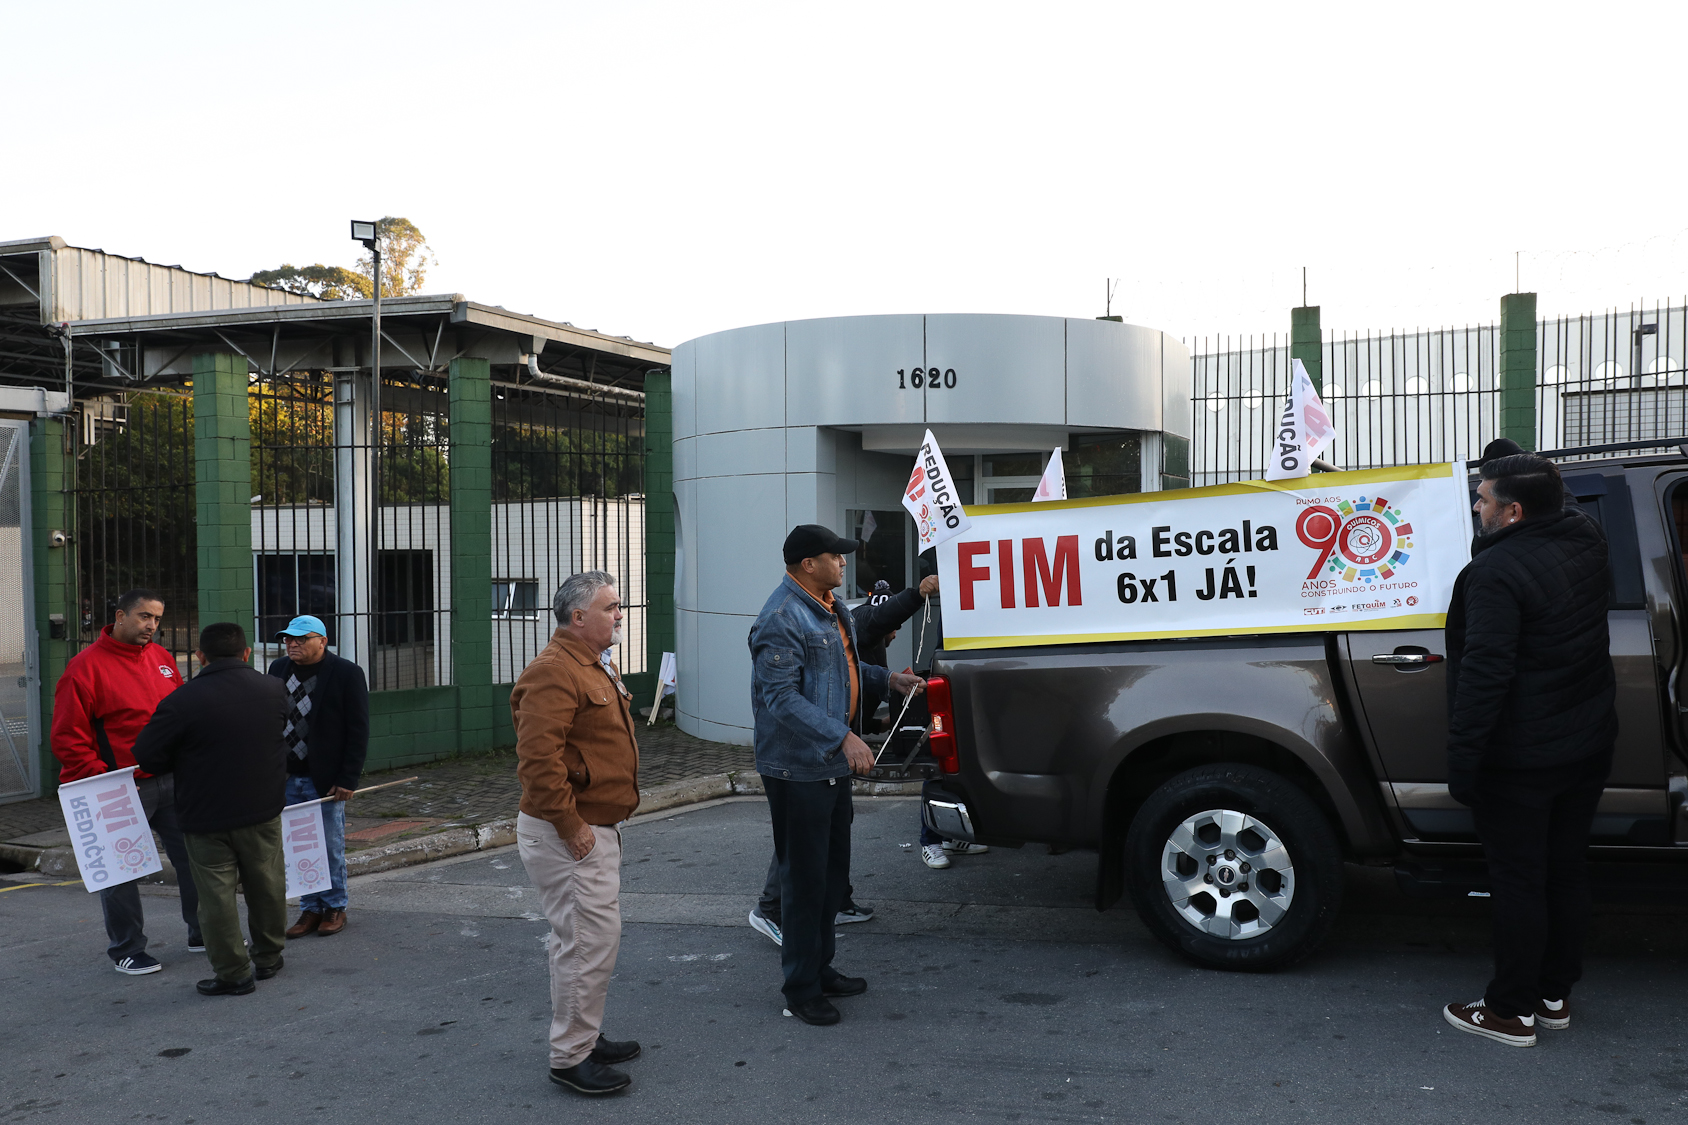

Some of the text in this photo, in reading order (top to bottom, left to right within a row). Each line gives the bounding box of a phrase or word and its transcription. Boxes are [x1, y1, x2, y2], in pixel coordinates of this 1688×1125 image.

[897, 367, 957, 389] 1620
[920, 442, 960, 529] REDUÇÃO
[1346, 517, 1381, 531] QUÍMICOS
[1094, 519, 1279, 562] da Escala
[957, 534, 1083, 611] FIM
[1116, 558, 1258, 604] 6x1 JÁ!
[1301, 580, 1337, 591] ANOS
[1301, 585, 1366, 598] CONSTRUINDO
[1380, 581, 1418, 591] FUTURO
[871, 594, 892, 607] CO
